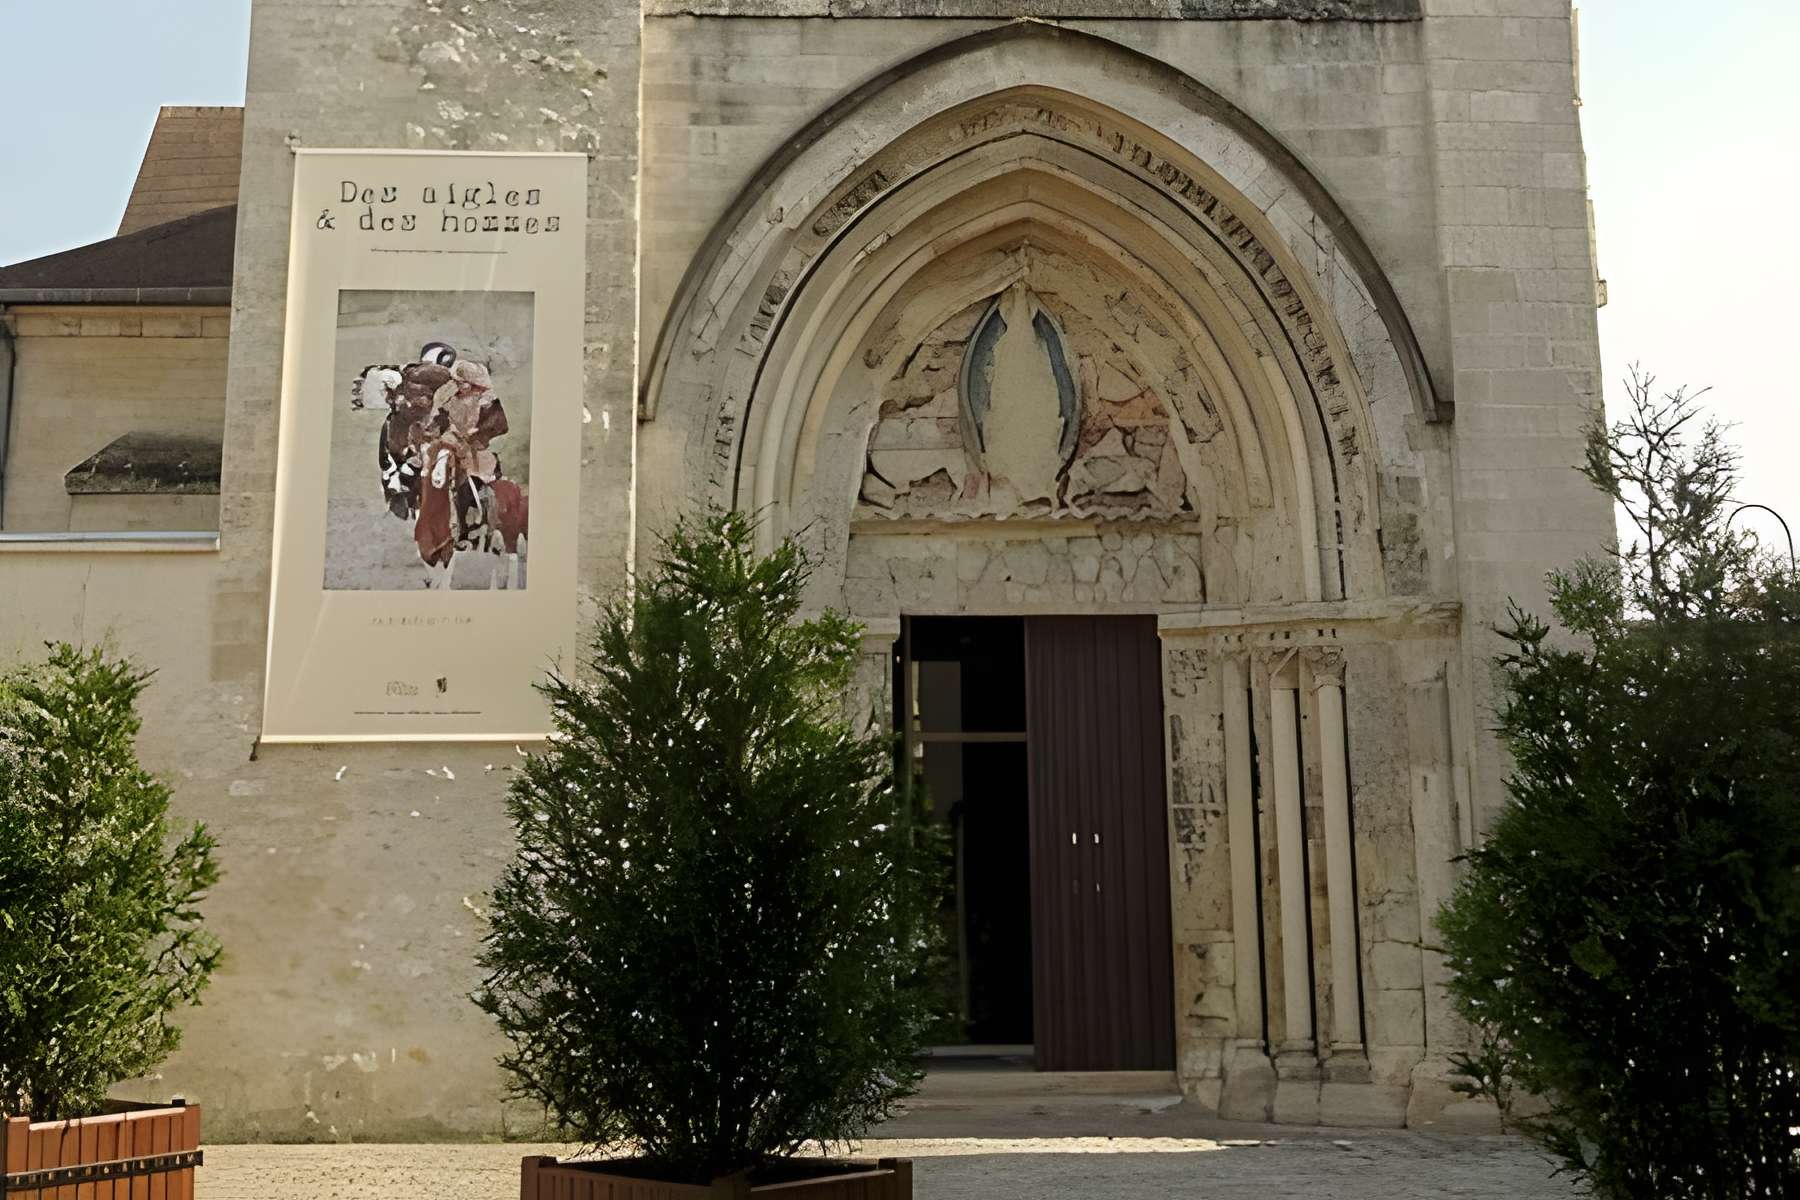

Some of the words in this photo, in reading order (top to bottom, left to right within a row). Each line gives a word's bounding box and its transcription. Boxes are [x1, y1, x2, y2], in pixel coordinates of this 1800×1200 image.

[340, 181, 397, 203] Des
[422, 182, 541, 209] aigles
[316, 209, 336, 230] &
[359, 206, 416, 232] des
